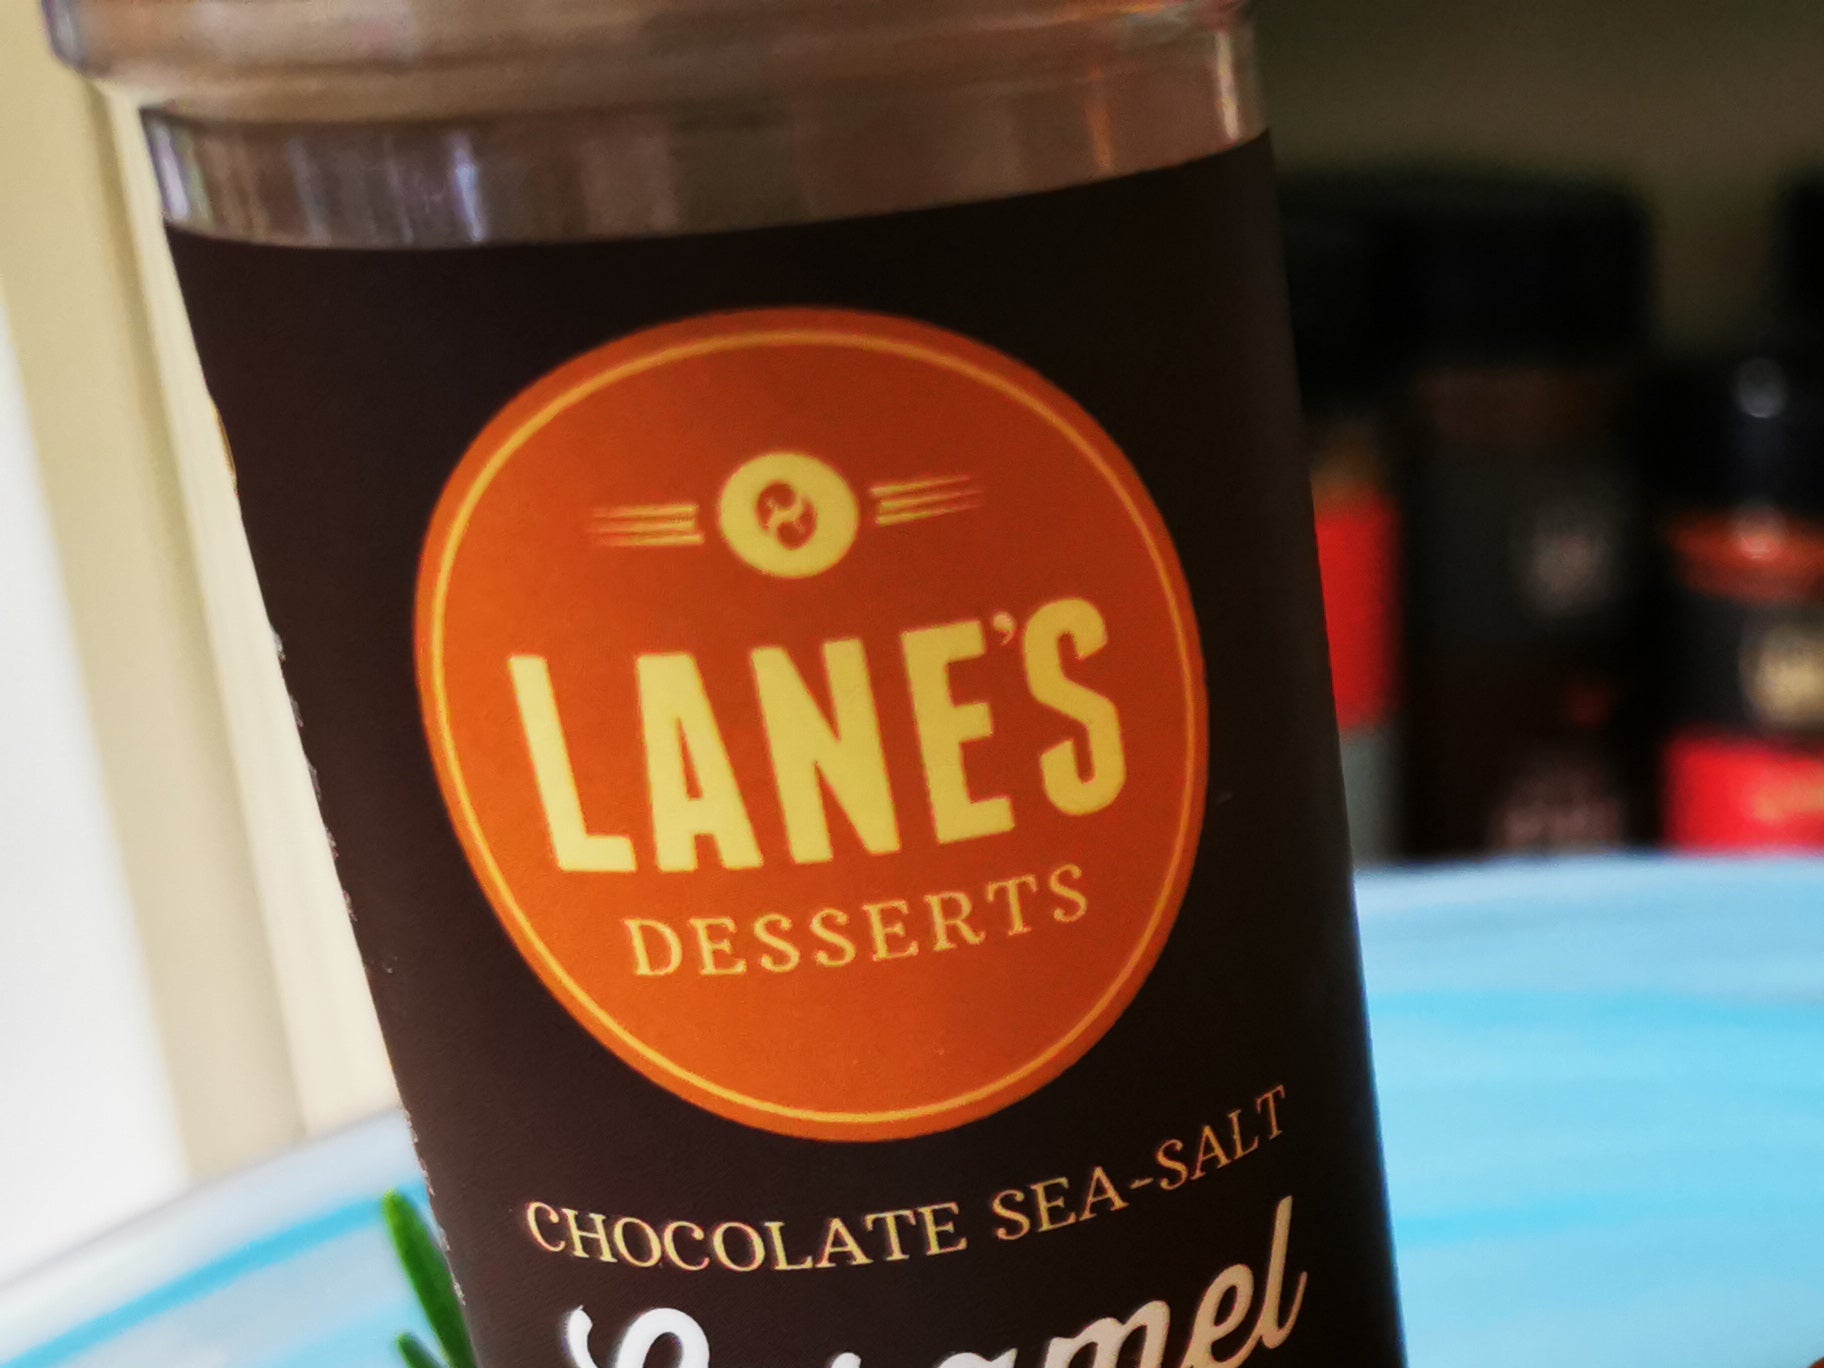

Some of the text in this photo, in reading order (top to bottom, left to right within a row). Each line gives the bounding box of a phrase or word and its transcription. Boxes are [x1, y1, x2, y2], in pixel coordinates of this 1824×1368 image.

[508, 597, 1126, 873] LANE'S
[623, 863, 1089, 977] DESSERTS
[525, 1085, 1288, 1272] CHOCOLATE SEA-SALT
